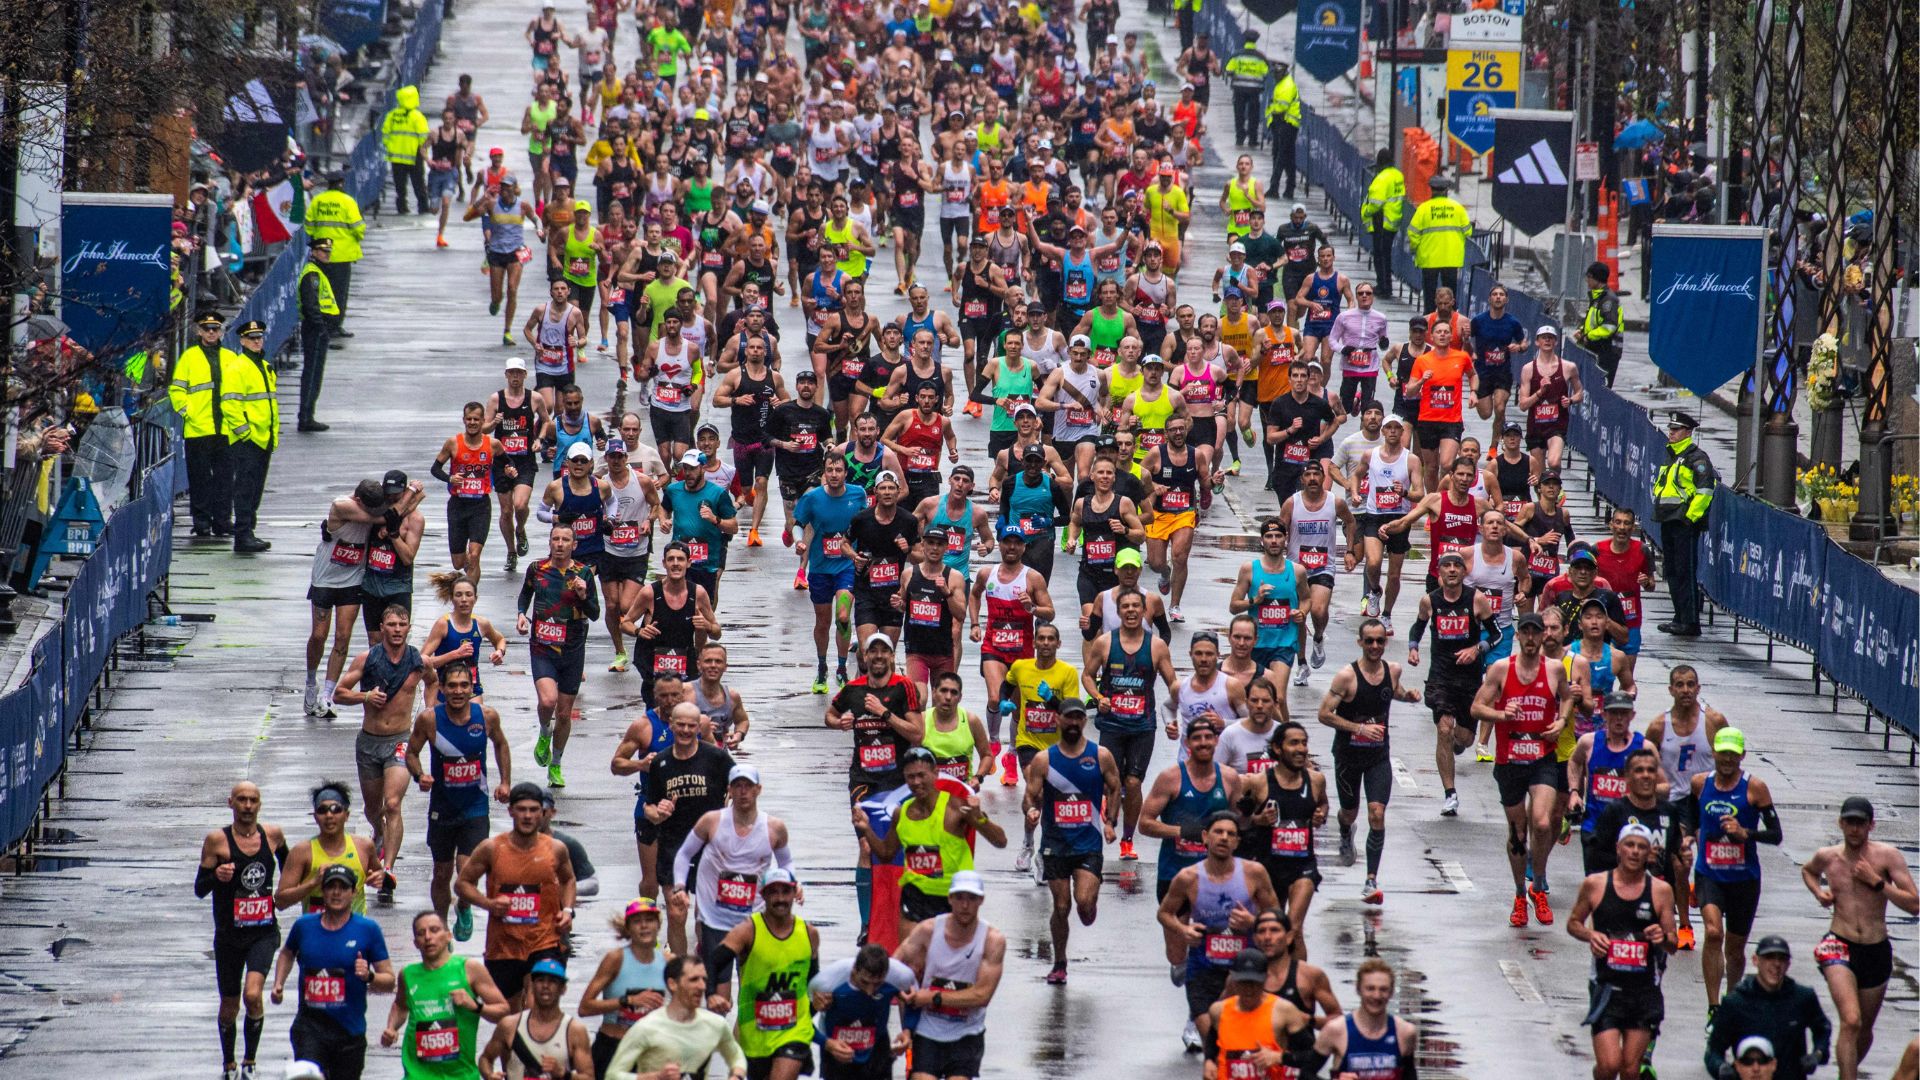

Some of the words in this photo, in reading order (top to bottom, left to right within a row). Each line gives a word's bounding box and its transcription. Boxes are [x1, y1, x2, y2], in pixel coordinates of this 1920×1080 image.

[1463, 13, 1511, 28] BOSTON
[1472, 50, 1497, 62] Mile
[1462, 62, 1503, 89] 26
[63, 240, 104, 274] John
[104, 240, 168, 271] Hancock
[1656, 272, 1698, 304] John
[1696, 272, 1756, 301] Hancock
[1165, 493, 1187, 504] 4011
[570, 519, 595, 532] 4050
[1446, 521, 1464, 529] ELITE
[67, 528, 90, 541] BPD
[67, 541, 92, 555] BPD
[335, 548, 361, 560] 5723
[1088, 542, 1113, 555] 5155
[370, 552, 393, 566] 4058
[872, 566, 897, 579] 2145
[911, 603, 938, 617] 5035
[537, 624, 563, 638] 2285
[1439, 619, 1465, 631] 3717
[995, 632, 1020, 643] 2244
[657, 656, 683, 670] 3821
[1114, 697, 1141, 710] 4457
[1504, 697, 1548, 711] GREATER
[1509, 709, 1545, 722] OSTON
[1512, 741, 1540, 755] 4505
[1678, 744, 1697, 772] F
[446, 765, 477, 779] 4878
[666, 775, 706, 790] BOSTON
[666, 787, 708, 799] COLLEGE
[720, 884, 752, 900] 2354
[238, 899, 270, 916] 2575
[420, 1032, 455, 1050] 4558
